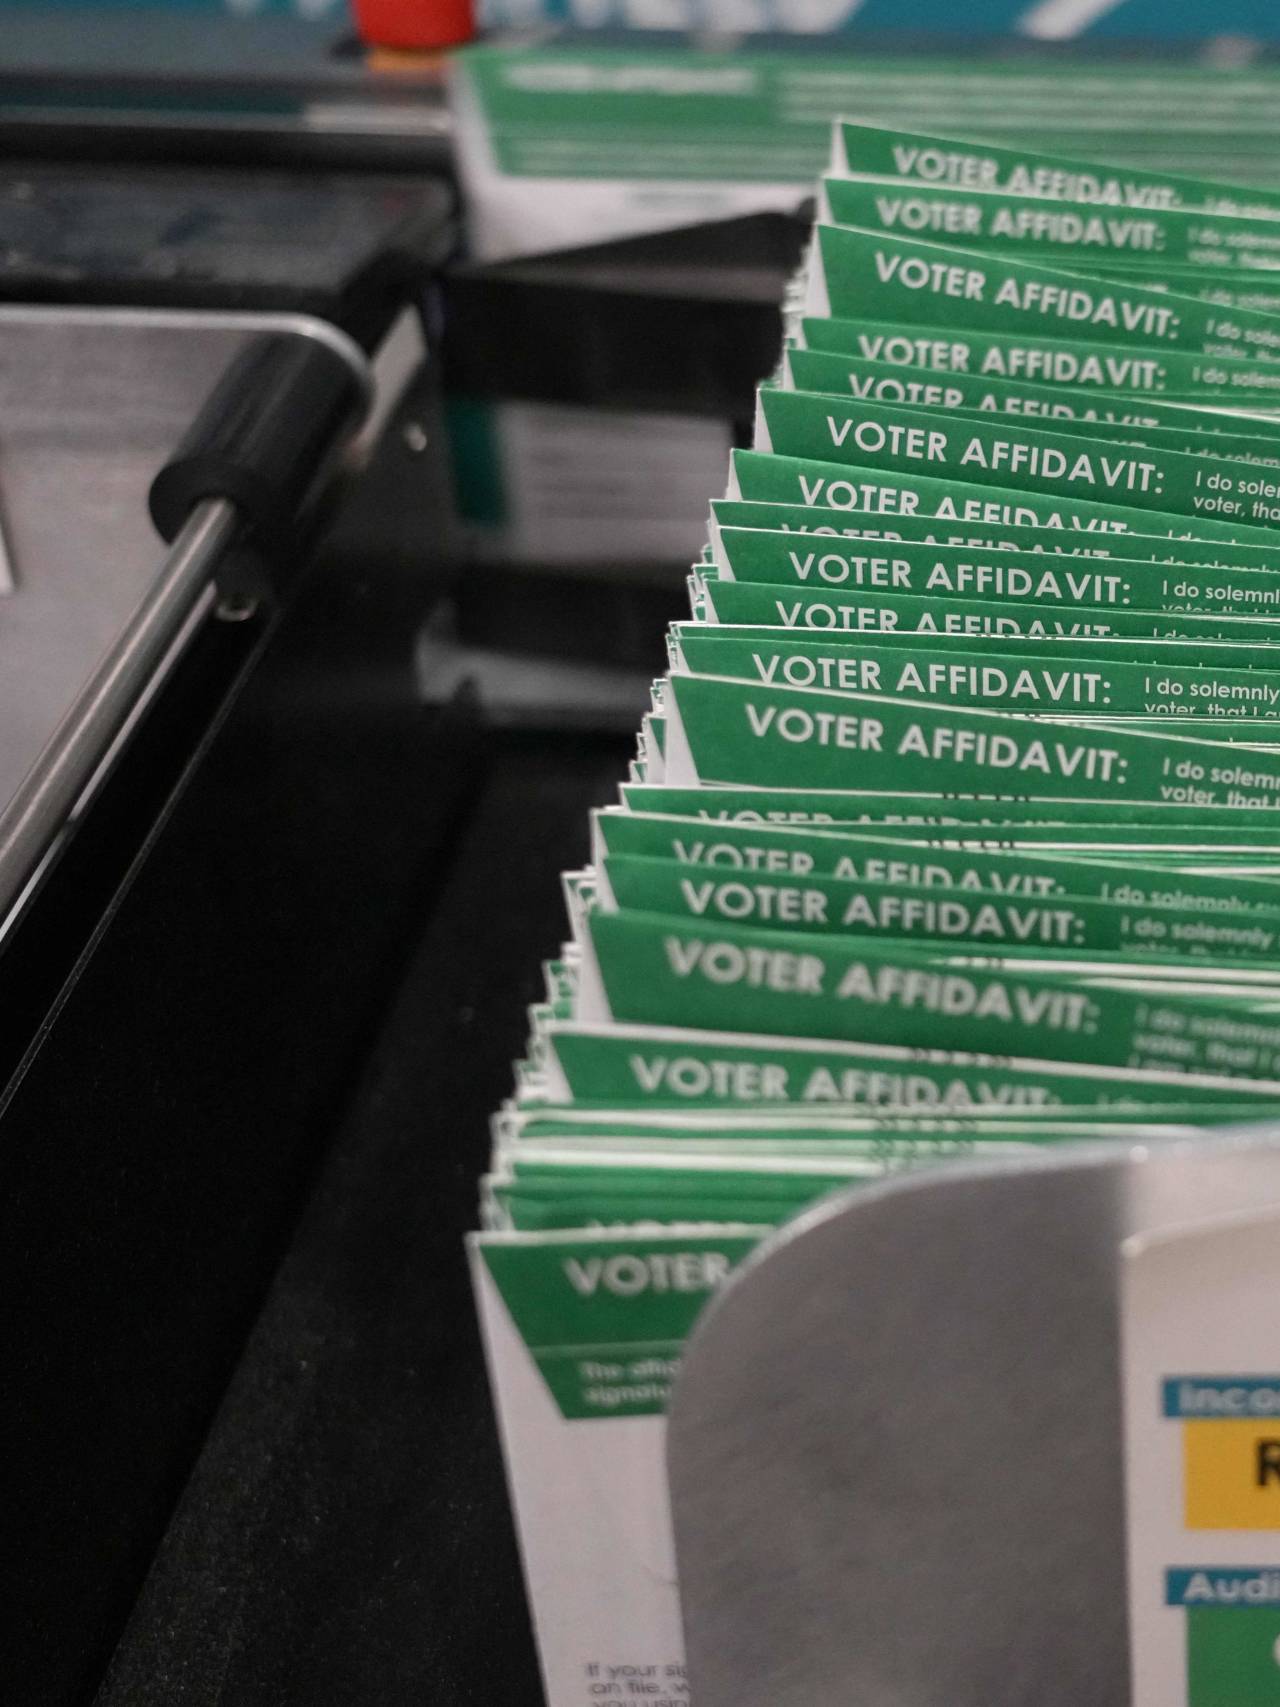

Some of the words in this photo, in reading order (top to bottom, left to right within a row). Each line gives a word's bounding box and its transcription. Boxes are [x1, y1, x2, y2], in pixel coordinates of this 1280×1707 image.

[893, 145, 998, 187] VOTER
[876, 197, 982, 235] VOTER
[991, 208, 1166, 251] AFFIDAVIT:
[876, 252, 987, 300] VOTER
[995, 279, 1181, 339] AFFIDAVIT:
[857, 334, 970, 371] VOTER
[981, 347, 1167, 391] AFFIDAVIT:
[826, 416, 948, 461] VOTER
[960, 438, 1165, 494] AFFIDAVIT:
[798, 475, 920, 516] VOTER
[1195, 470, 1202, 487] I
[1207, 473, 1232, 491] do
[1193, 496, 1246, 518] voter,
[789, 551, 912, 588] VOTER
[926, 562, 1131, 605] AFFIDAVIT:
[1162, 579, 1168, 596] I
[1173, 581, 1200, 598] do
[776, 601, 899, 632] VOTER
[752, 653, 882, 690] VOTER
[895, 662, 1111, 705] AFFIDAVIT:
[1145, 676, 1151, 694] I
[1157, 678, 1183, 695] do
[1190, 681, 1280, 705] solemnly
[746, 704, 884, 752] VOTER
[898, 724, 1129, 784] AFFIDAVIT:
[1163, 757, 1171, 775] I
[1176, 760, 1205, 780] do
[673, 839, 815, 875] VOTER
[681, 879, 828, 922] VOTER
[842, 895, 1086, 945] AFFIDAVIT:
[1134, 917, 1167, 938] do
[1171, 921, 1274, 950] solemnly
[663, 935, 826, 995] VOTER
[836, 963, 1100, 1034] AFFIDAVIT:
[629, 1053, 790, 1101] VOTER
[564, 1252, 733, 1297] VOTER
